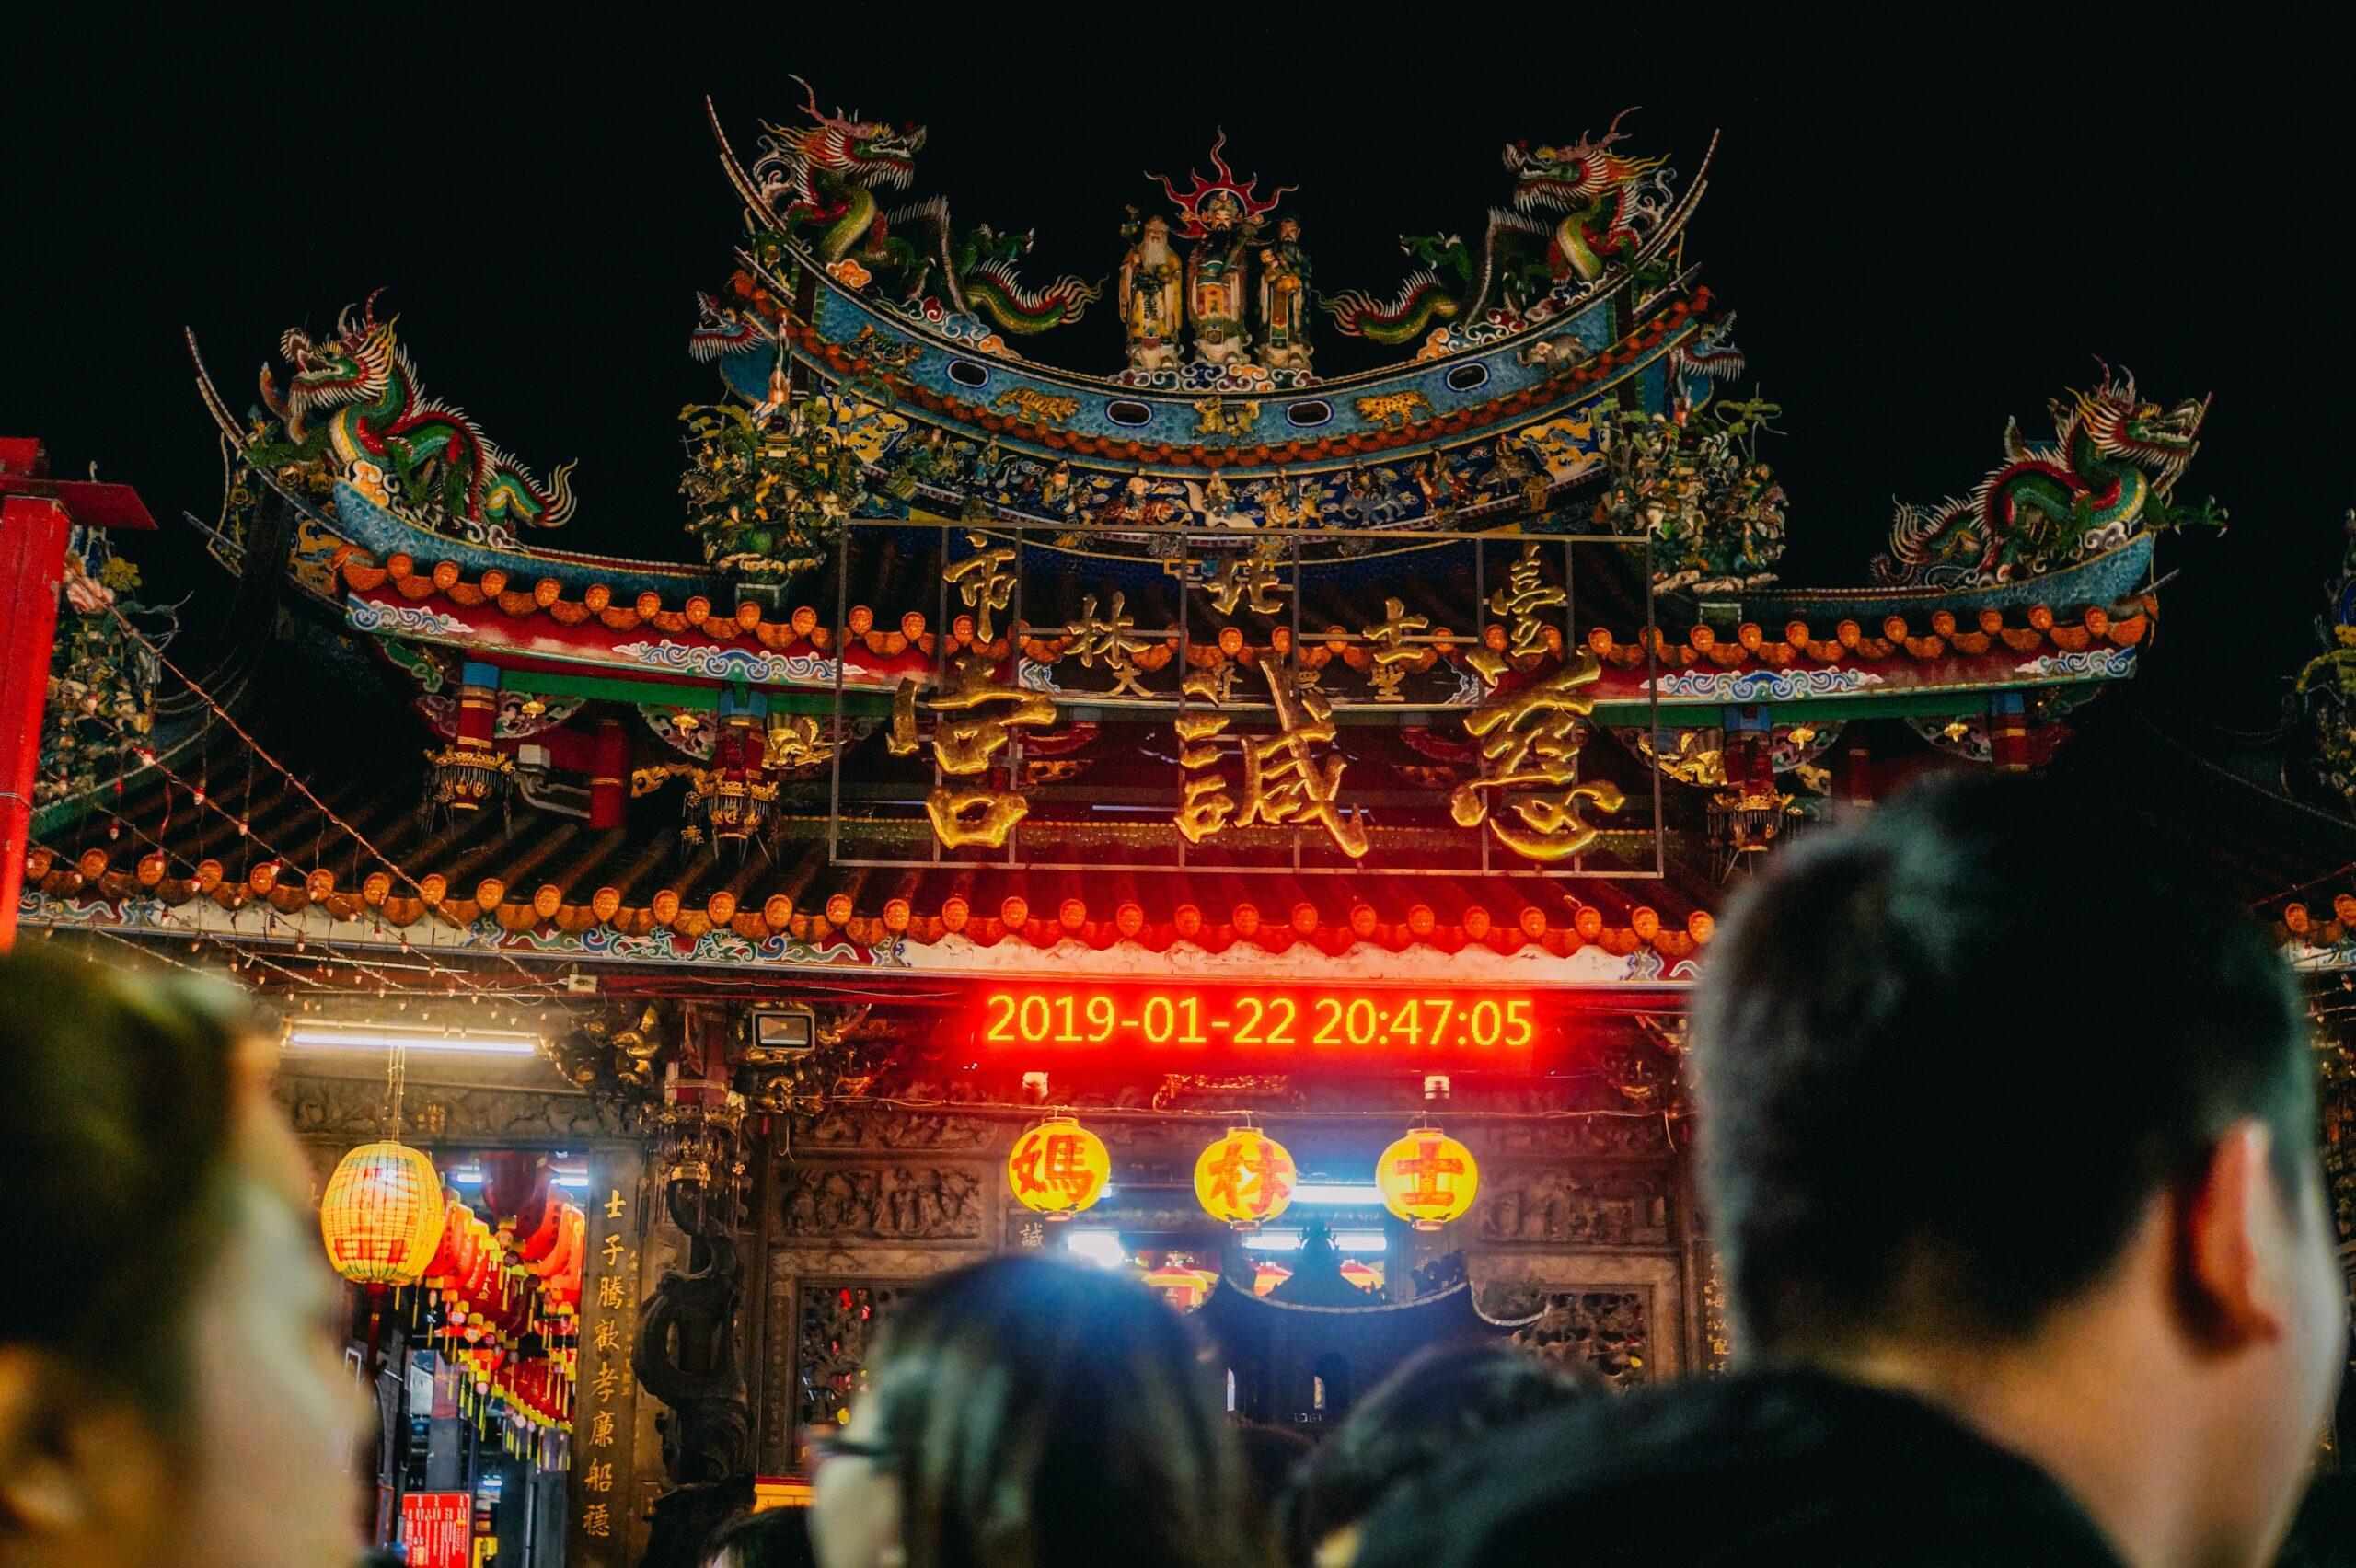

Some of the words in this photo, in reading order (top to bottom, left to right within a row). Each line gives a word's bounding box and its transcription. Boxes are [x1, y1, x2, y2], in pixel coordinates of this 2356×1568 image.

[988, 995, 1295, 1043] 2019-01-22
[1313, 998, 1531, 1045] 20:47:05
[1012, 1134, 1095, 1202] 媽
[1208, 1143, 1290, 1215] 林
[1395, 1140, 1465, 1206] 士
